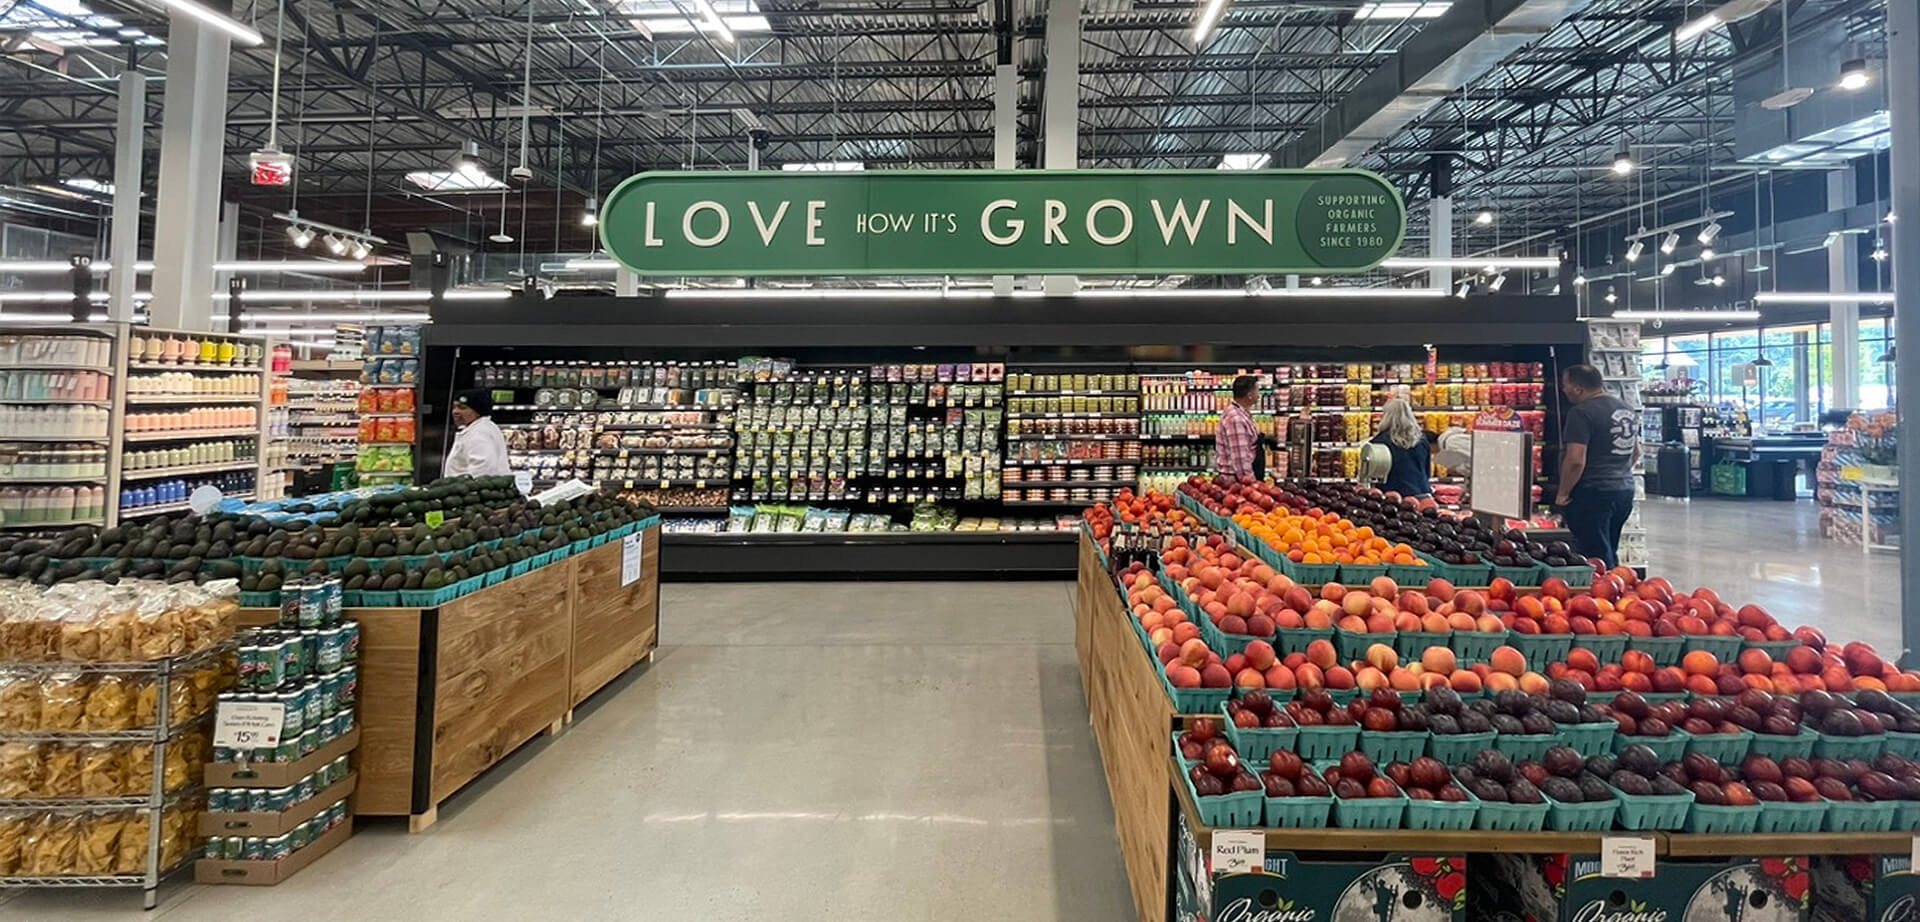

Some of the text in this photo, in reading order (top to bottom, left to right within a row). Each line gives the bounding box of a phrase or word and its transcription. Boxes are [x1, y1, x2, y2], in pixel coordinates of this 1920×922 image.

[1317, 195, 1386, 206] SUPPORTING
[1327, 209, 1375, 219] ORGANIC
[644, 198, 1273, 247] LOVE HOW IT'S GROWN
[1326, 223, 1377, 233] FARMERS
[1320, 236, 1384, 247] SINCE 1980
[73, 256, 90, 266] 10
[1237, 845, 1259, 854] Plum
